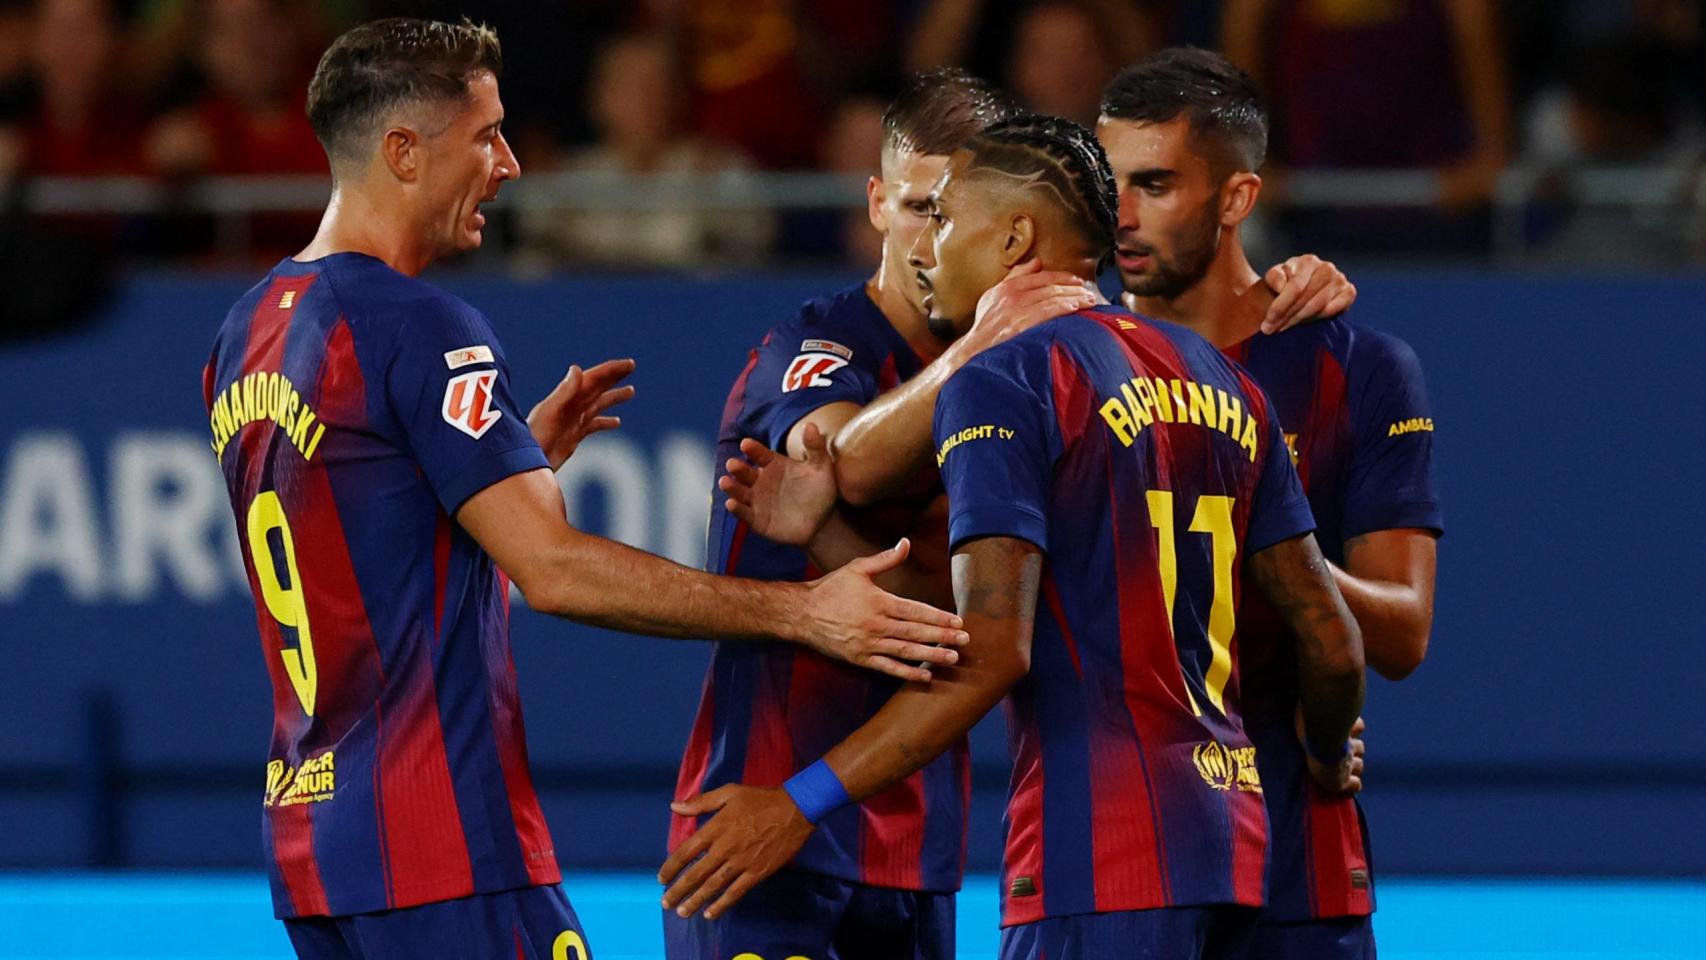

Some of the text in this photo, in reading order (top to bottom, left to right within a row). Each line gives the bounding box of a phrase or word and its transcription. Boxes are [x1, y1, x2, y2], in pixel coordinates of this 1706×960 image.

[998, 427, 1014, 440] tv
[1098, 376, 1257, 463] RAPHINHA
[247, 490, 317, 717] 9
[1145, 490, 1237, 716] 11
